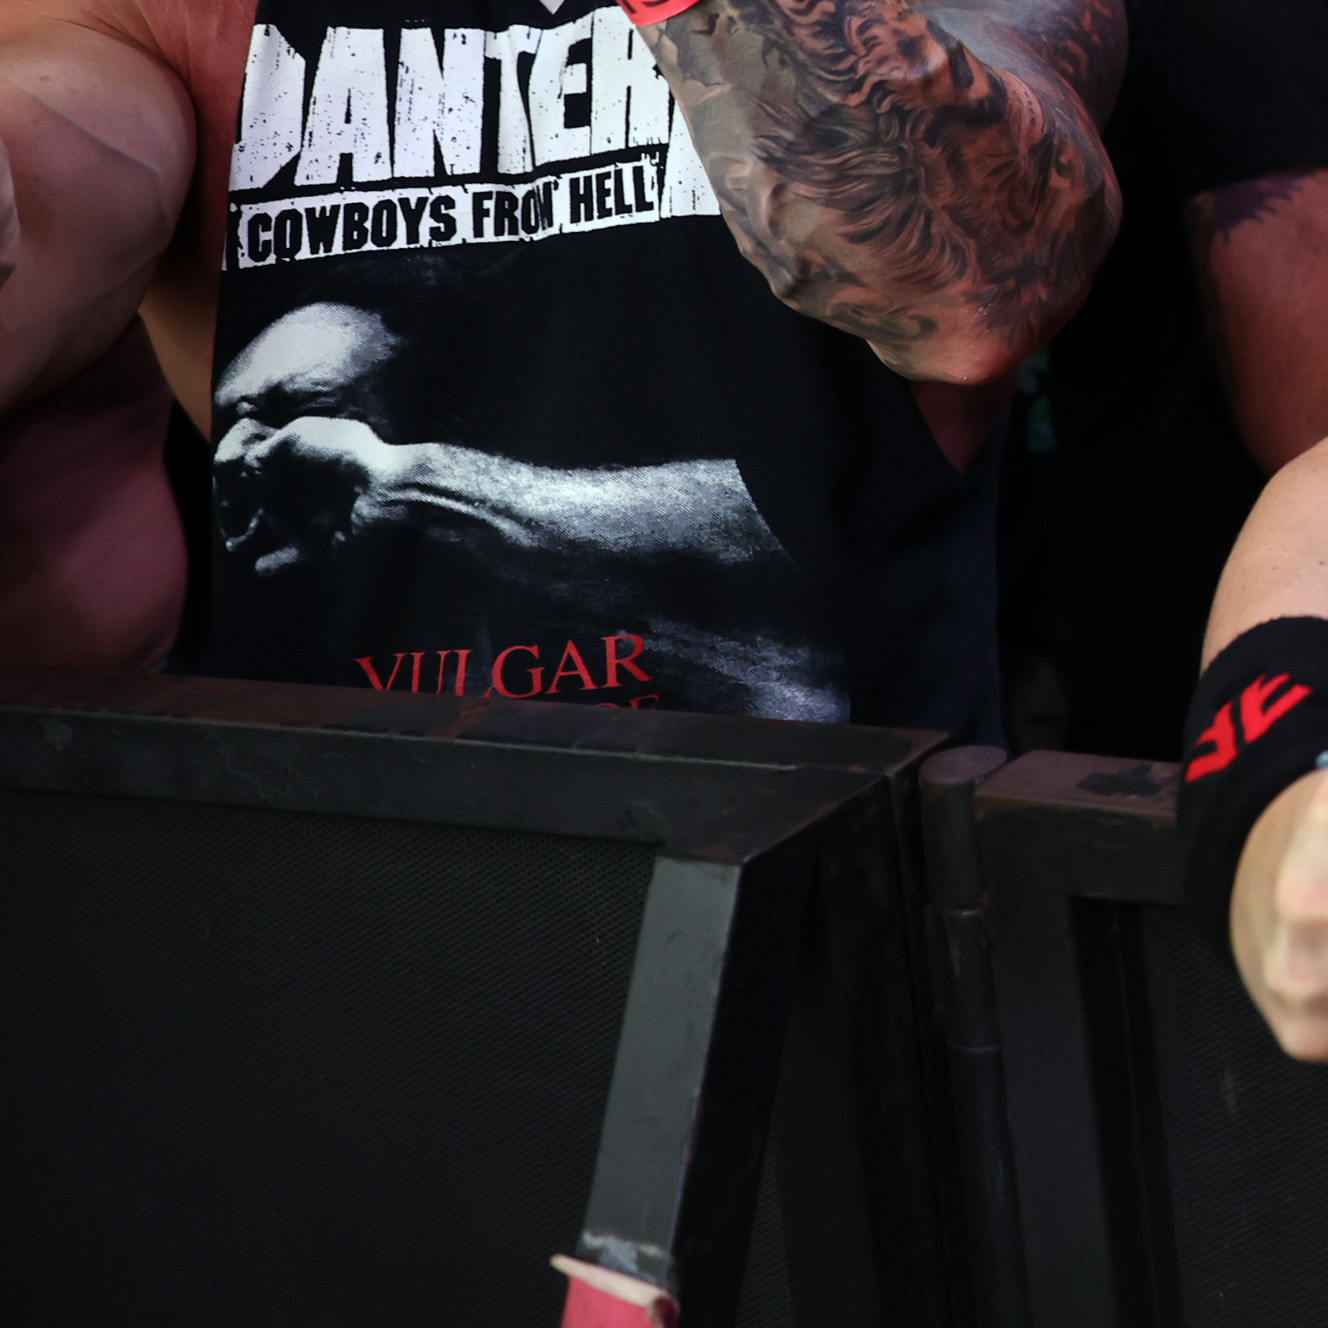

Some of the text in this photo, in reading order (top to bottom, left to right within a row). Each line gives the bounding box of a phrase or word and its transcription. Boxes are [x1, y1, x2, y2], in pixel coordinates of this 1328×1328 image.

[247, 195, 457, 263] COWBOYS
[570, 164, 656, 224] HELL
[353, 633, 653, 699] VULGAR
